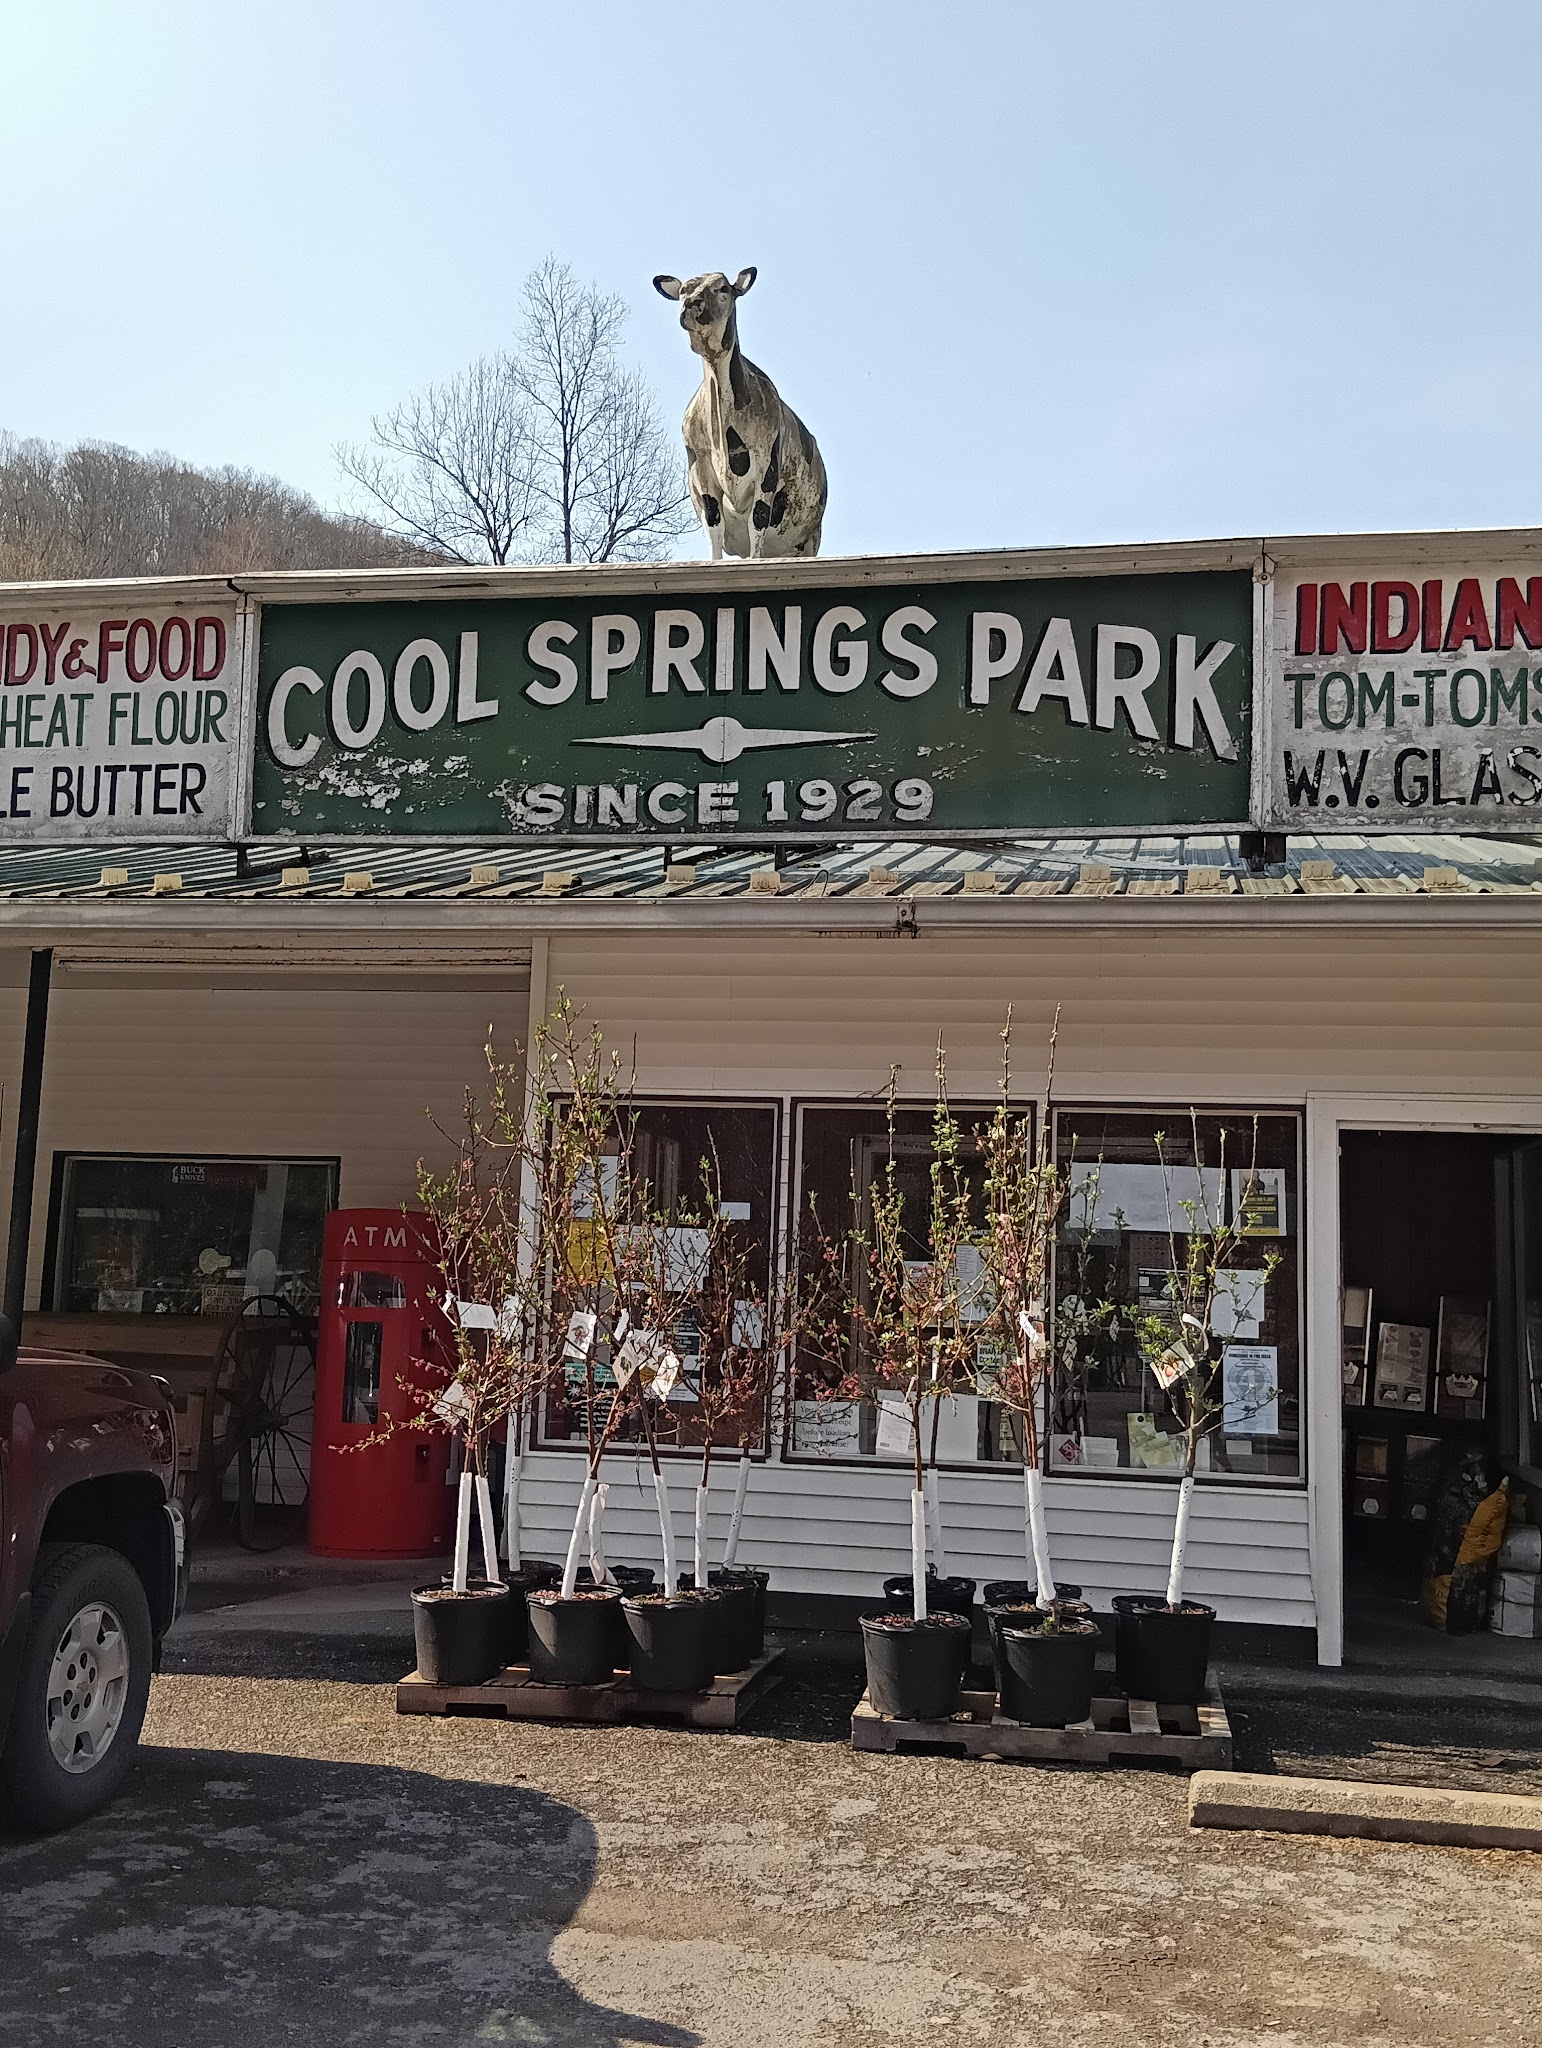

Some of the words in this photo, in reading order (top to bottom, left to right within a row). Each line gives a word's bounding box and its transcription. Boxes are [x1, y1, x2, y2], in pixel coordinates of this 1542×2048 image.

[1295, 576, 1542, 655] INDIAN
[262, 631, 499, 769] COOL
[522, 605, 939, 707] SPRINGS
[967, 611, 1240, 762] PARK
[0, 692, 95, 749] HEAT
[108, 690, 228, 747] FLOUR
[50, 762, 204, 818] BUTTER
[522, 779, 740, 828] SINCE
[764, 778, 936, 823] 1929
[180, 1165, 206, 1174] BUCK
[180, 1174, 206, 1182] KNIVES
[343, 1226, 407, 1248] ATM
